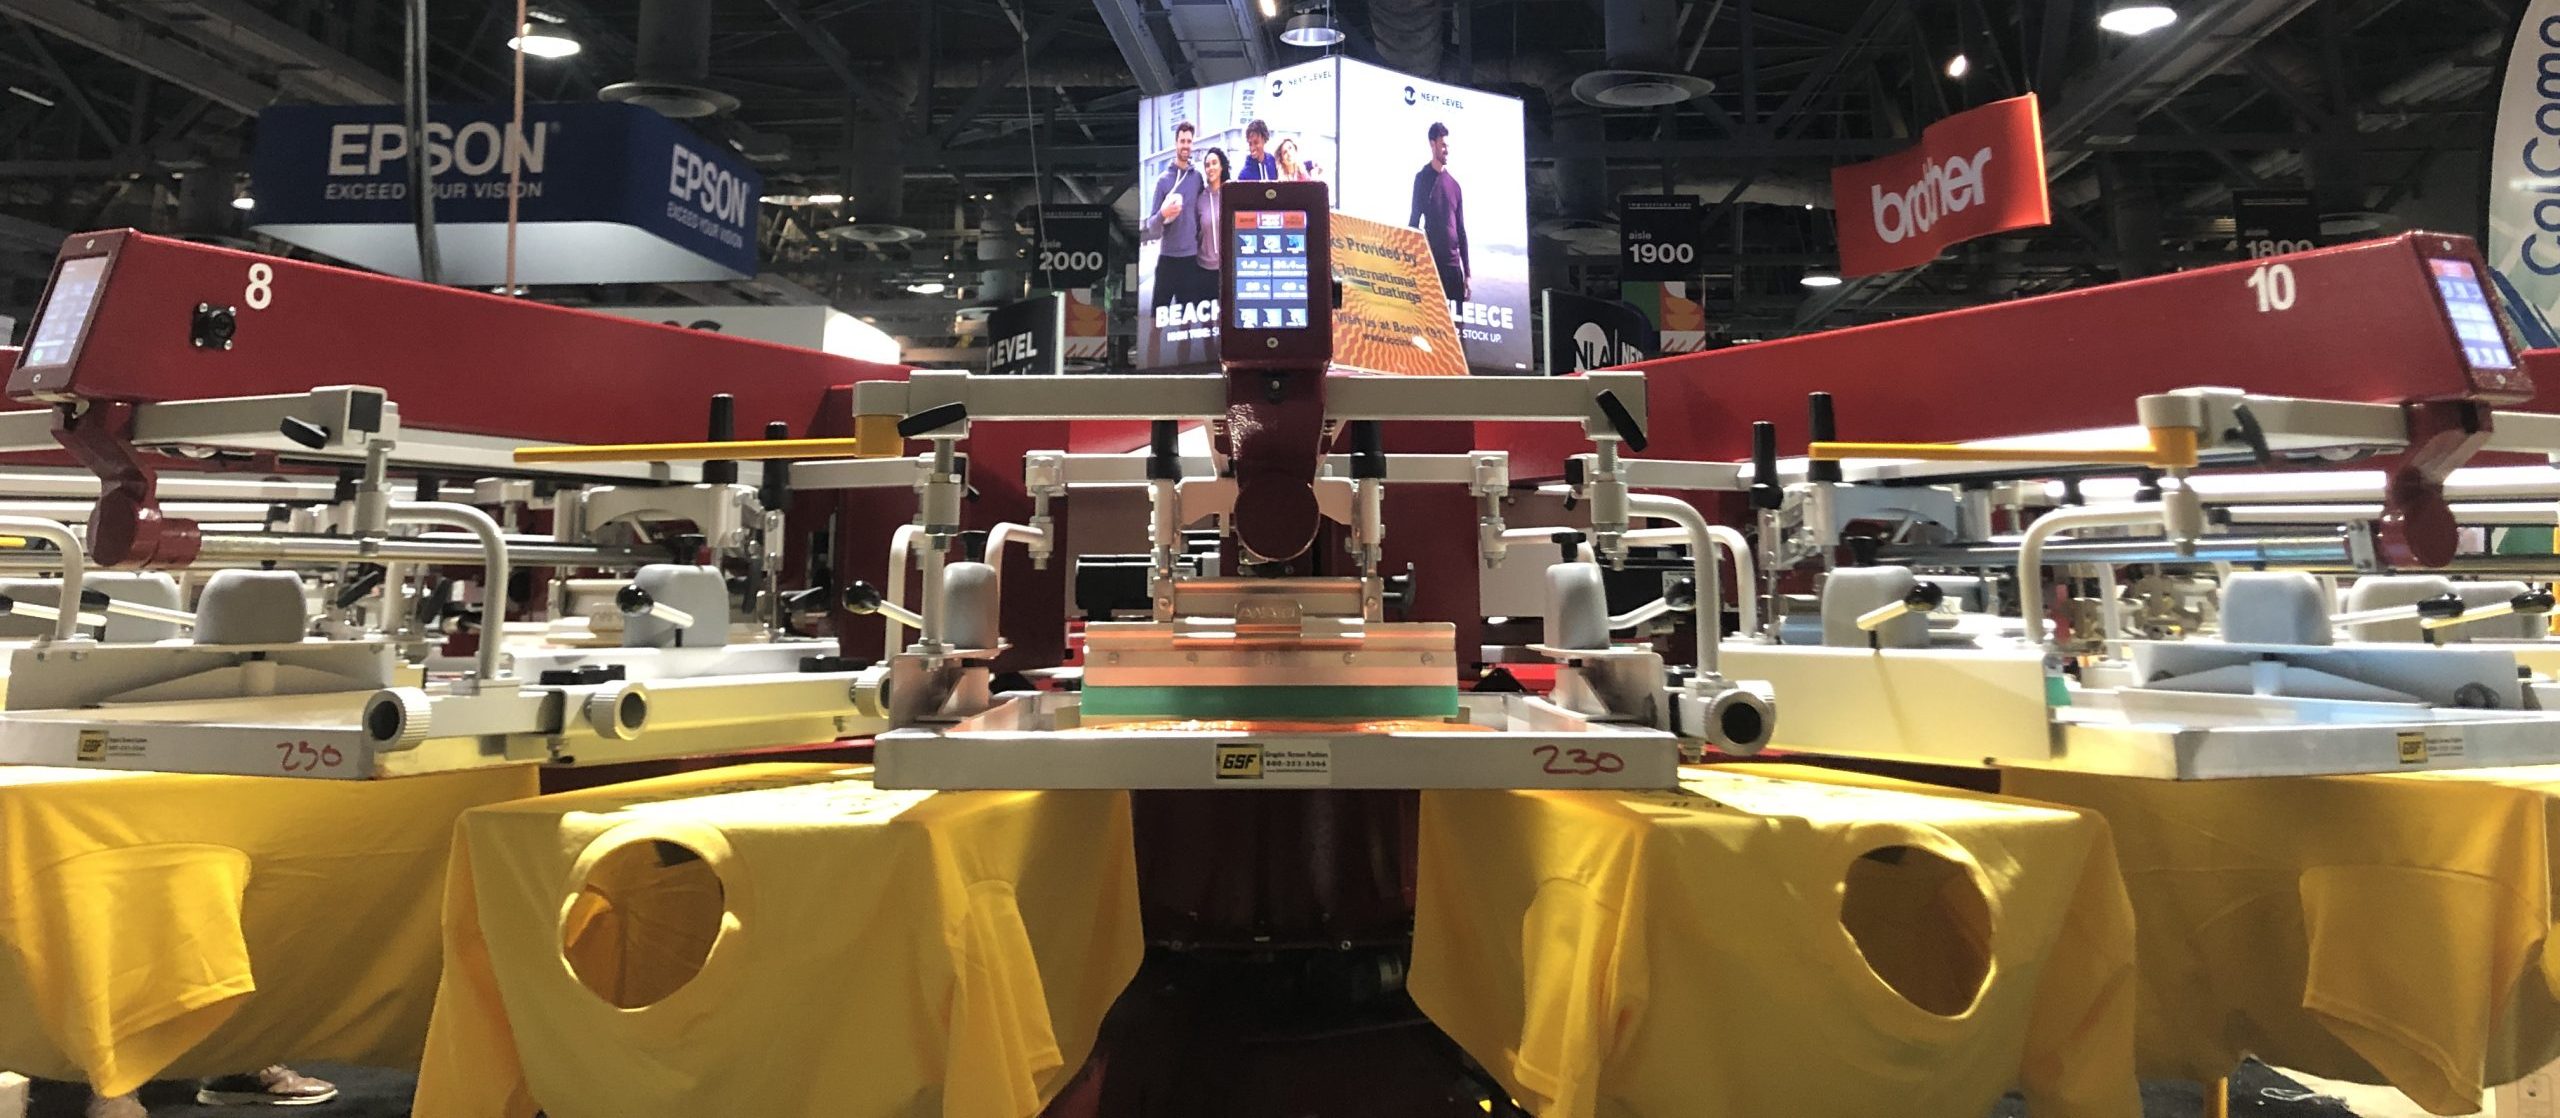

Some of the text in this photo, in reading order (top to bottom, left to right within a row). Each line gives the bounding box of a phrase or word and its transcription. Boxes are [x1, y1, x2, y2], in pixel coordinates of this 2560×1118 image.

[328, 121, 546, 176] EPSON
[325, 183, 406, 200] EXCEED
[474, 181, 543, 198] VISON
[669, 143, 747, 228] EPSON
[1871, 147, 1992, 243] brother
[1628, 230, 1652, 240] aisle
[1039, 251, 1103, 271] 2000
[1346, 237, 1401, 261] Provided
[1403, 250, 1417, 267] by
[1629, 243, 1694, 264] 1900
[245, 262, 273, 310] 8
[1342, 264, 1417, 288] International
[2247, 263, 2296, 312] 10
[1371, 282, 1422, 304] Coatings
[1380, 321, 1390, 330] at
[1393, 321, 1421, 336] Booth
[1463, 329, 1488, 341] STOCK
[1223, 753, 1257, 770] GSF
[1532, 745, 1625, 775] 230
